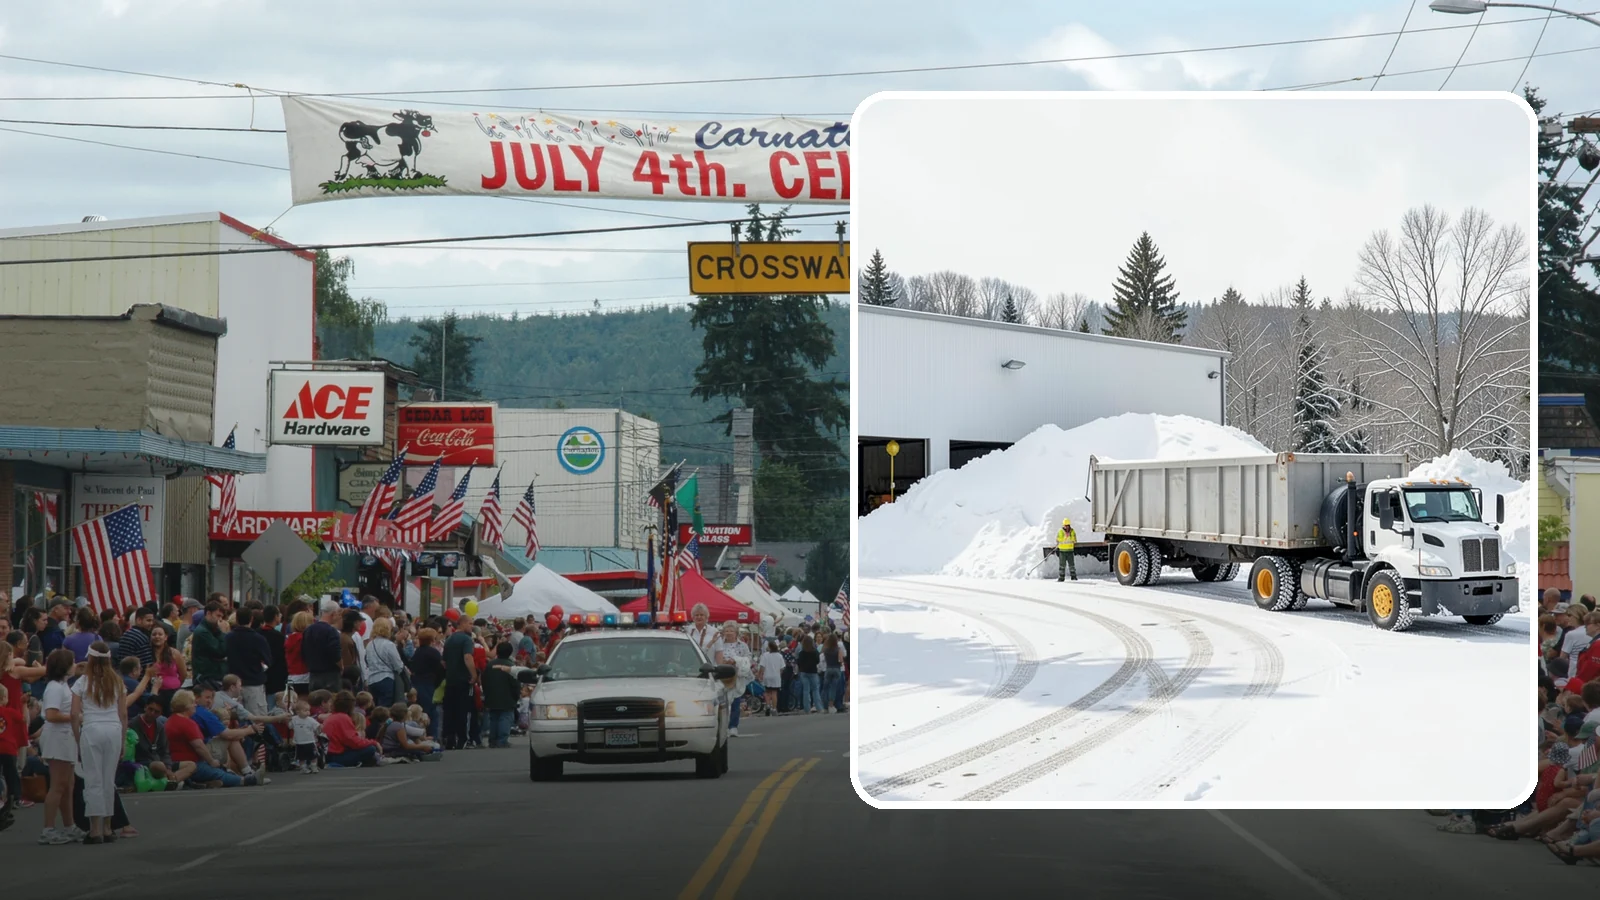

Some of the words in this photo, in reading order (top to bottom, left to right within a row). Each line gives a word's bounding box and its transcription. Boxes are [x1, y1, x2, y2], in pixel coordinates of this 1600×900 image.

[481, 141, 604, 193] JULY
[632, 150, 746, 198] 4th.
[697, 254, 850, 280] CROSSWA
[282, 380, 374, 420] ACE
[406, 409, 452, 422] CEDAR
[461, 409, 485, 422] LOG
[283, 421, 371, 436] Hardware
[416, 428, 477, 447] Coca-Cola
[95, 485, 124, 494] Vincent
[126, 485, 136, 494] de
[137, 486, 155, 495] Paul
[688, 527, 741, 535] CRNATION
[699, 535, 730, 543] GLASS
